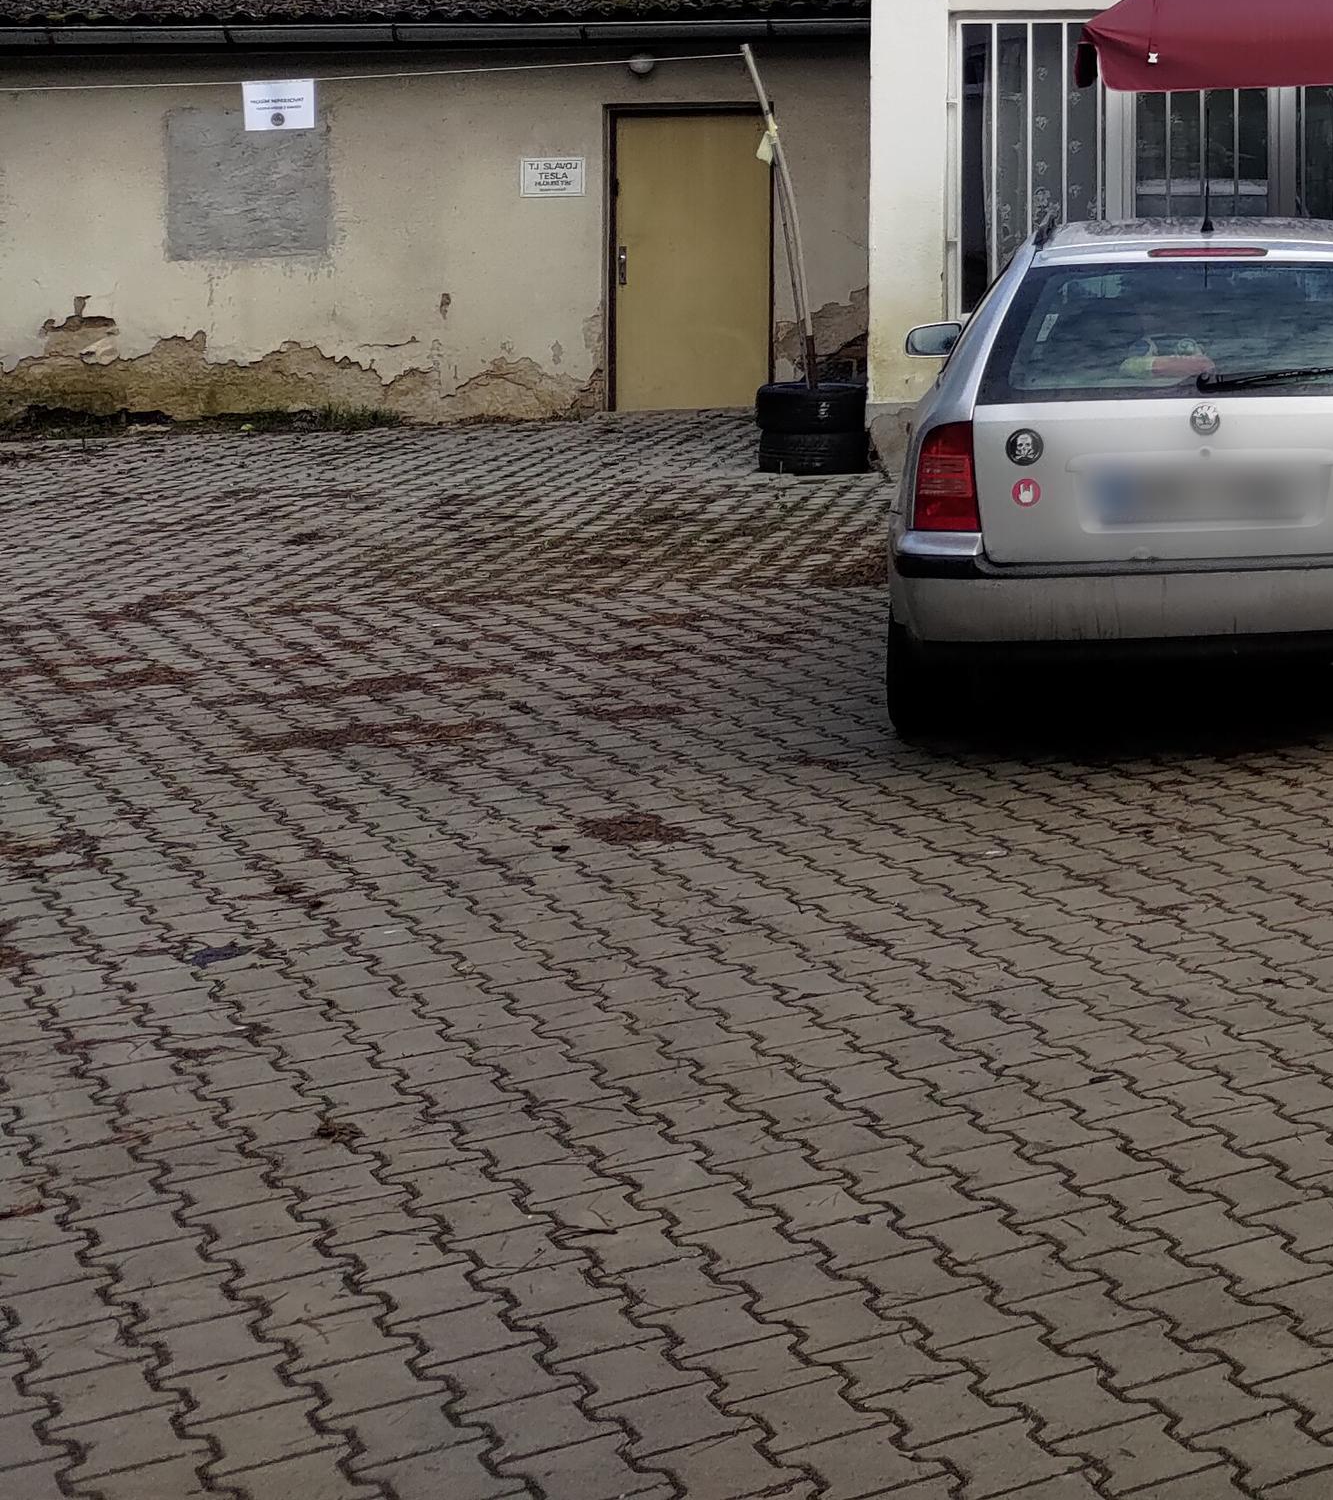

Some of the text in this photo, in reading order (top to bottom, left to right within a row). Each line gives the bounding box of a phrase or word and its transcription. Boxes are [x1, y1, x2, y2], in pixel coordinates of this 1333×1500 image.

[528, 162, 578, 170] TJ SLAVOJ
[538, 172, 568, 180] TESLA
